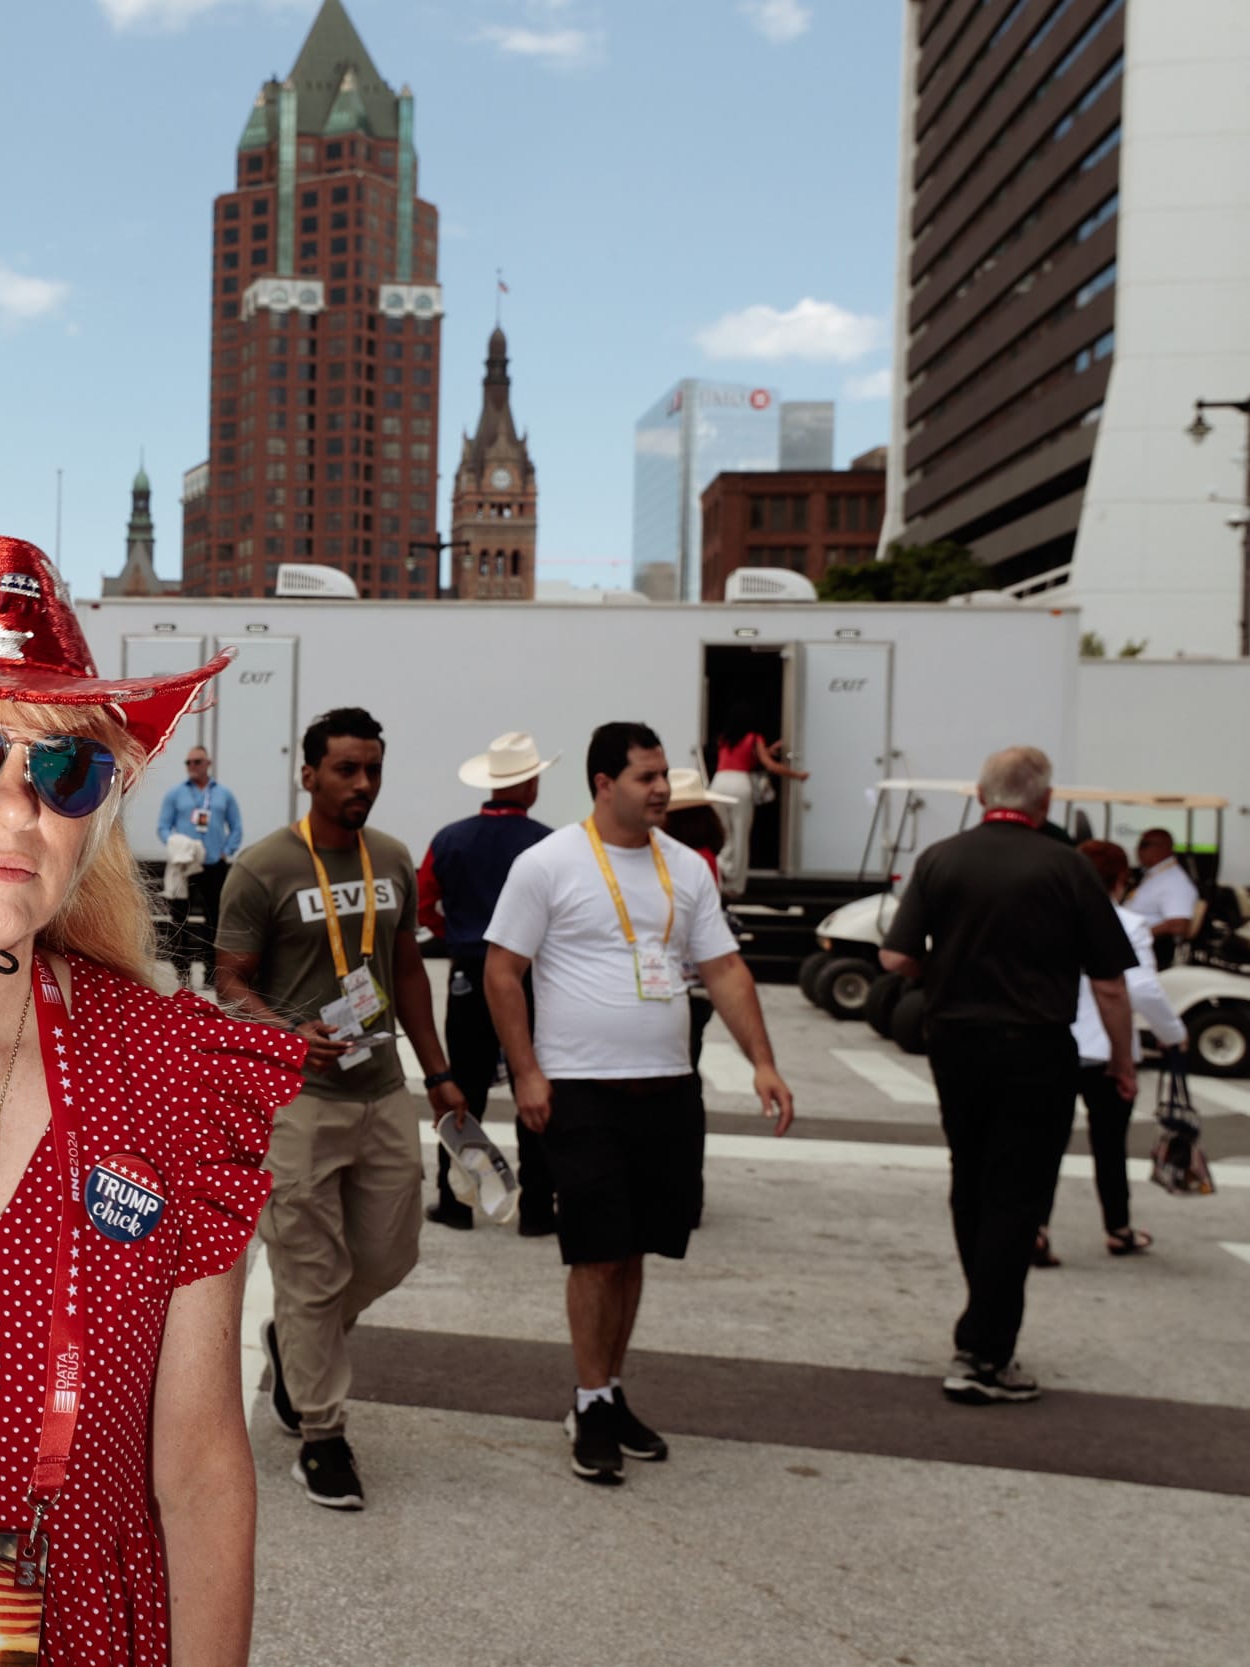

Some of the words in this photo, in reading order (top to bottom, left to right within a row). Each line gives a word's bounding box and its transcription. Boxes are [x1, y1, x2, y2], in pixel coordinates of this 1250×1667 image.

[239, 671, 275, 685] EXIT
[828, 678, 868, 692] EXIT
[66, 1130, 80, 1202] RNC2024
[96, 1172, 159, 1216] TRUMP
[93, 1201, 143, 1237] chick
[55, 1352, 68, 1389] DATA
[66, 1343, 79, 1389] TRUST
